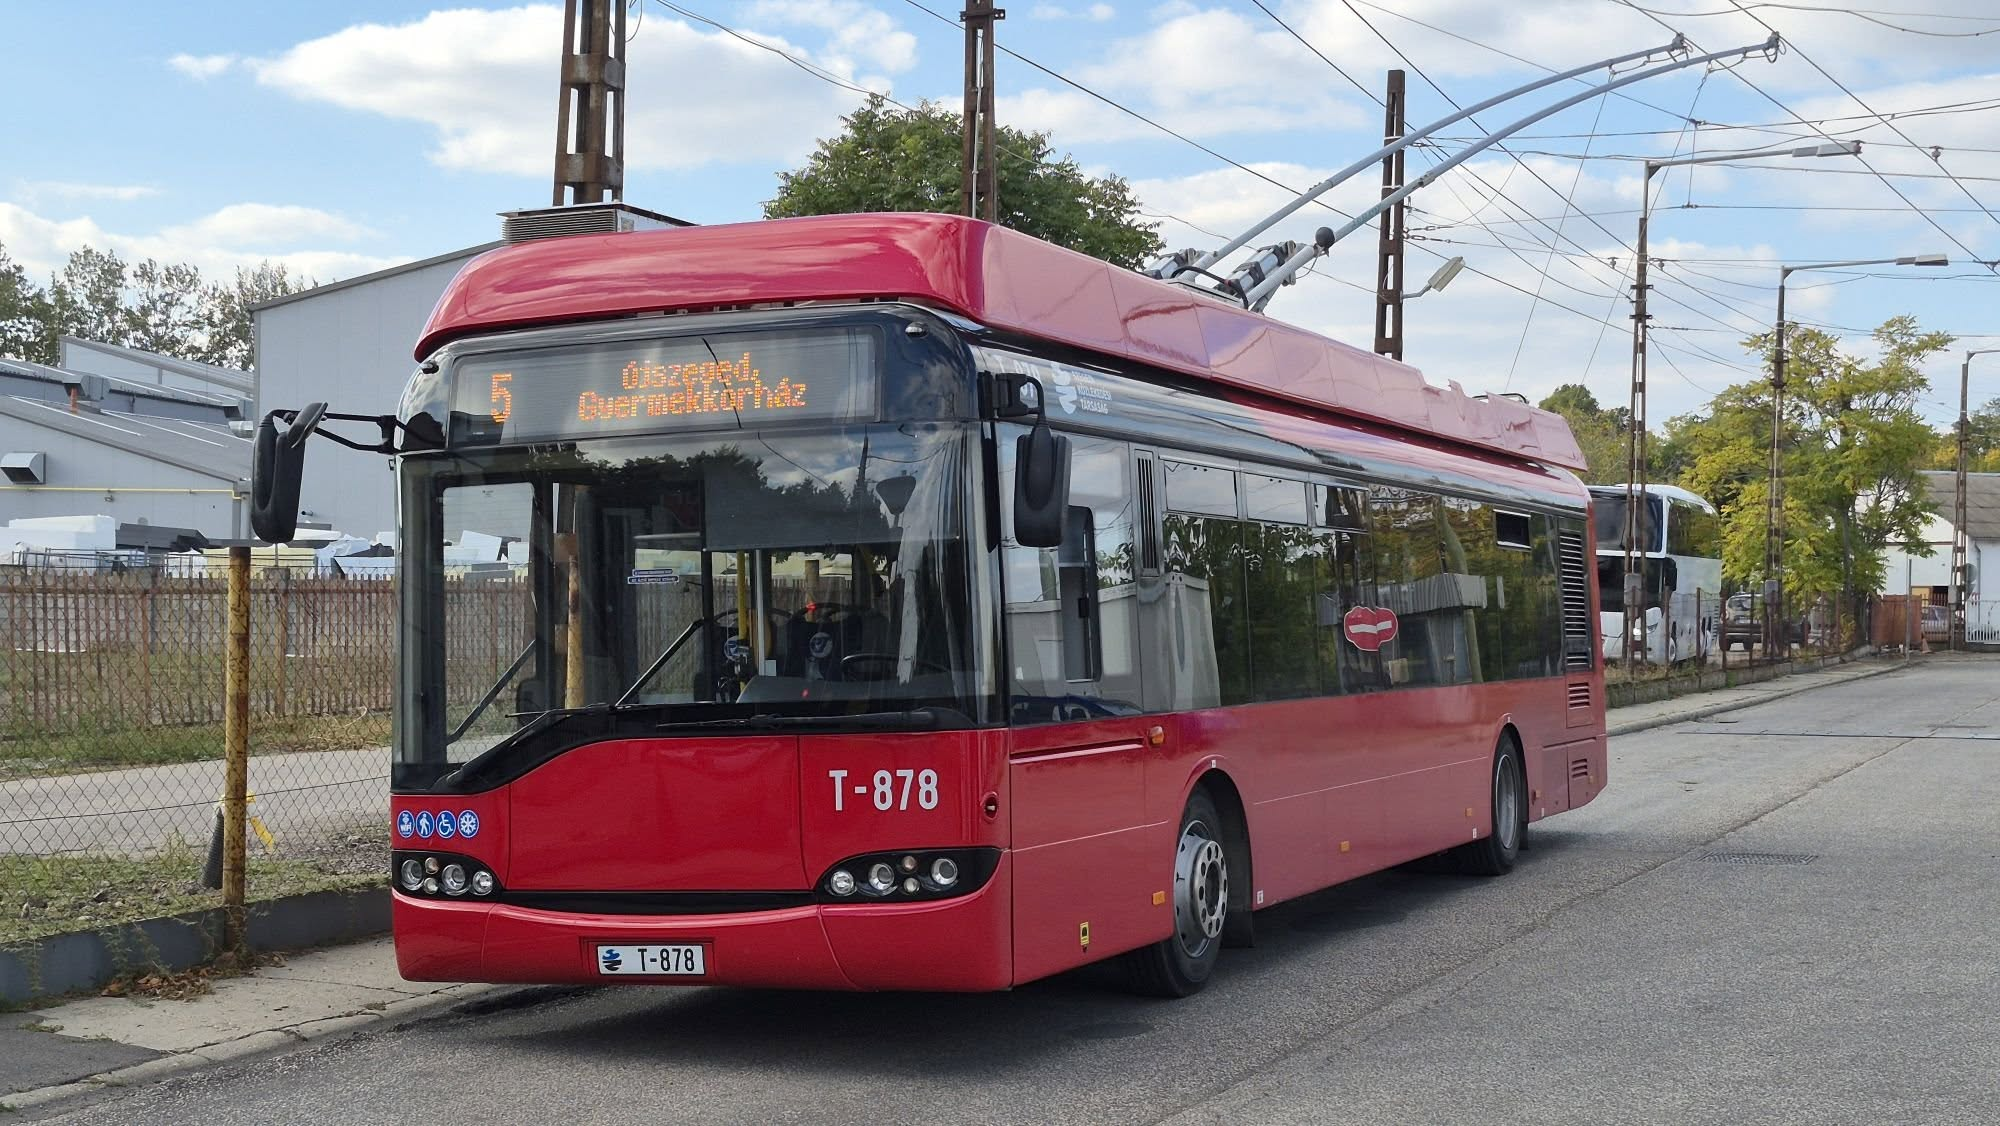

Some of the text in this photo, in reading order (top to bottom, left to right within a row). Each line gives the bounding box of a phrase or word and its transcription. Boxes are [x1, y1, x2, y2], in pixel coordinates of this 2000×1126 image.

[491, 373, 512, 422] 5
[829, 769, 938, 811] T-878
[638, 948, 695, 972] T-878
